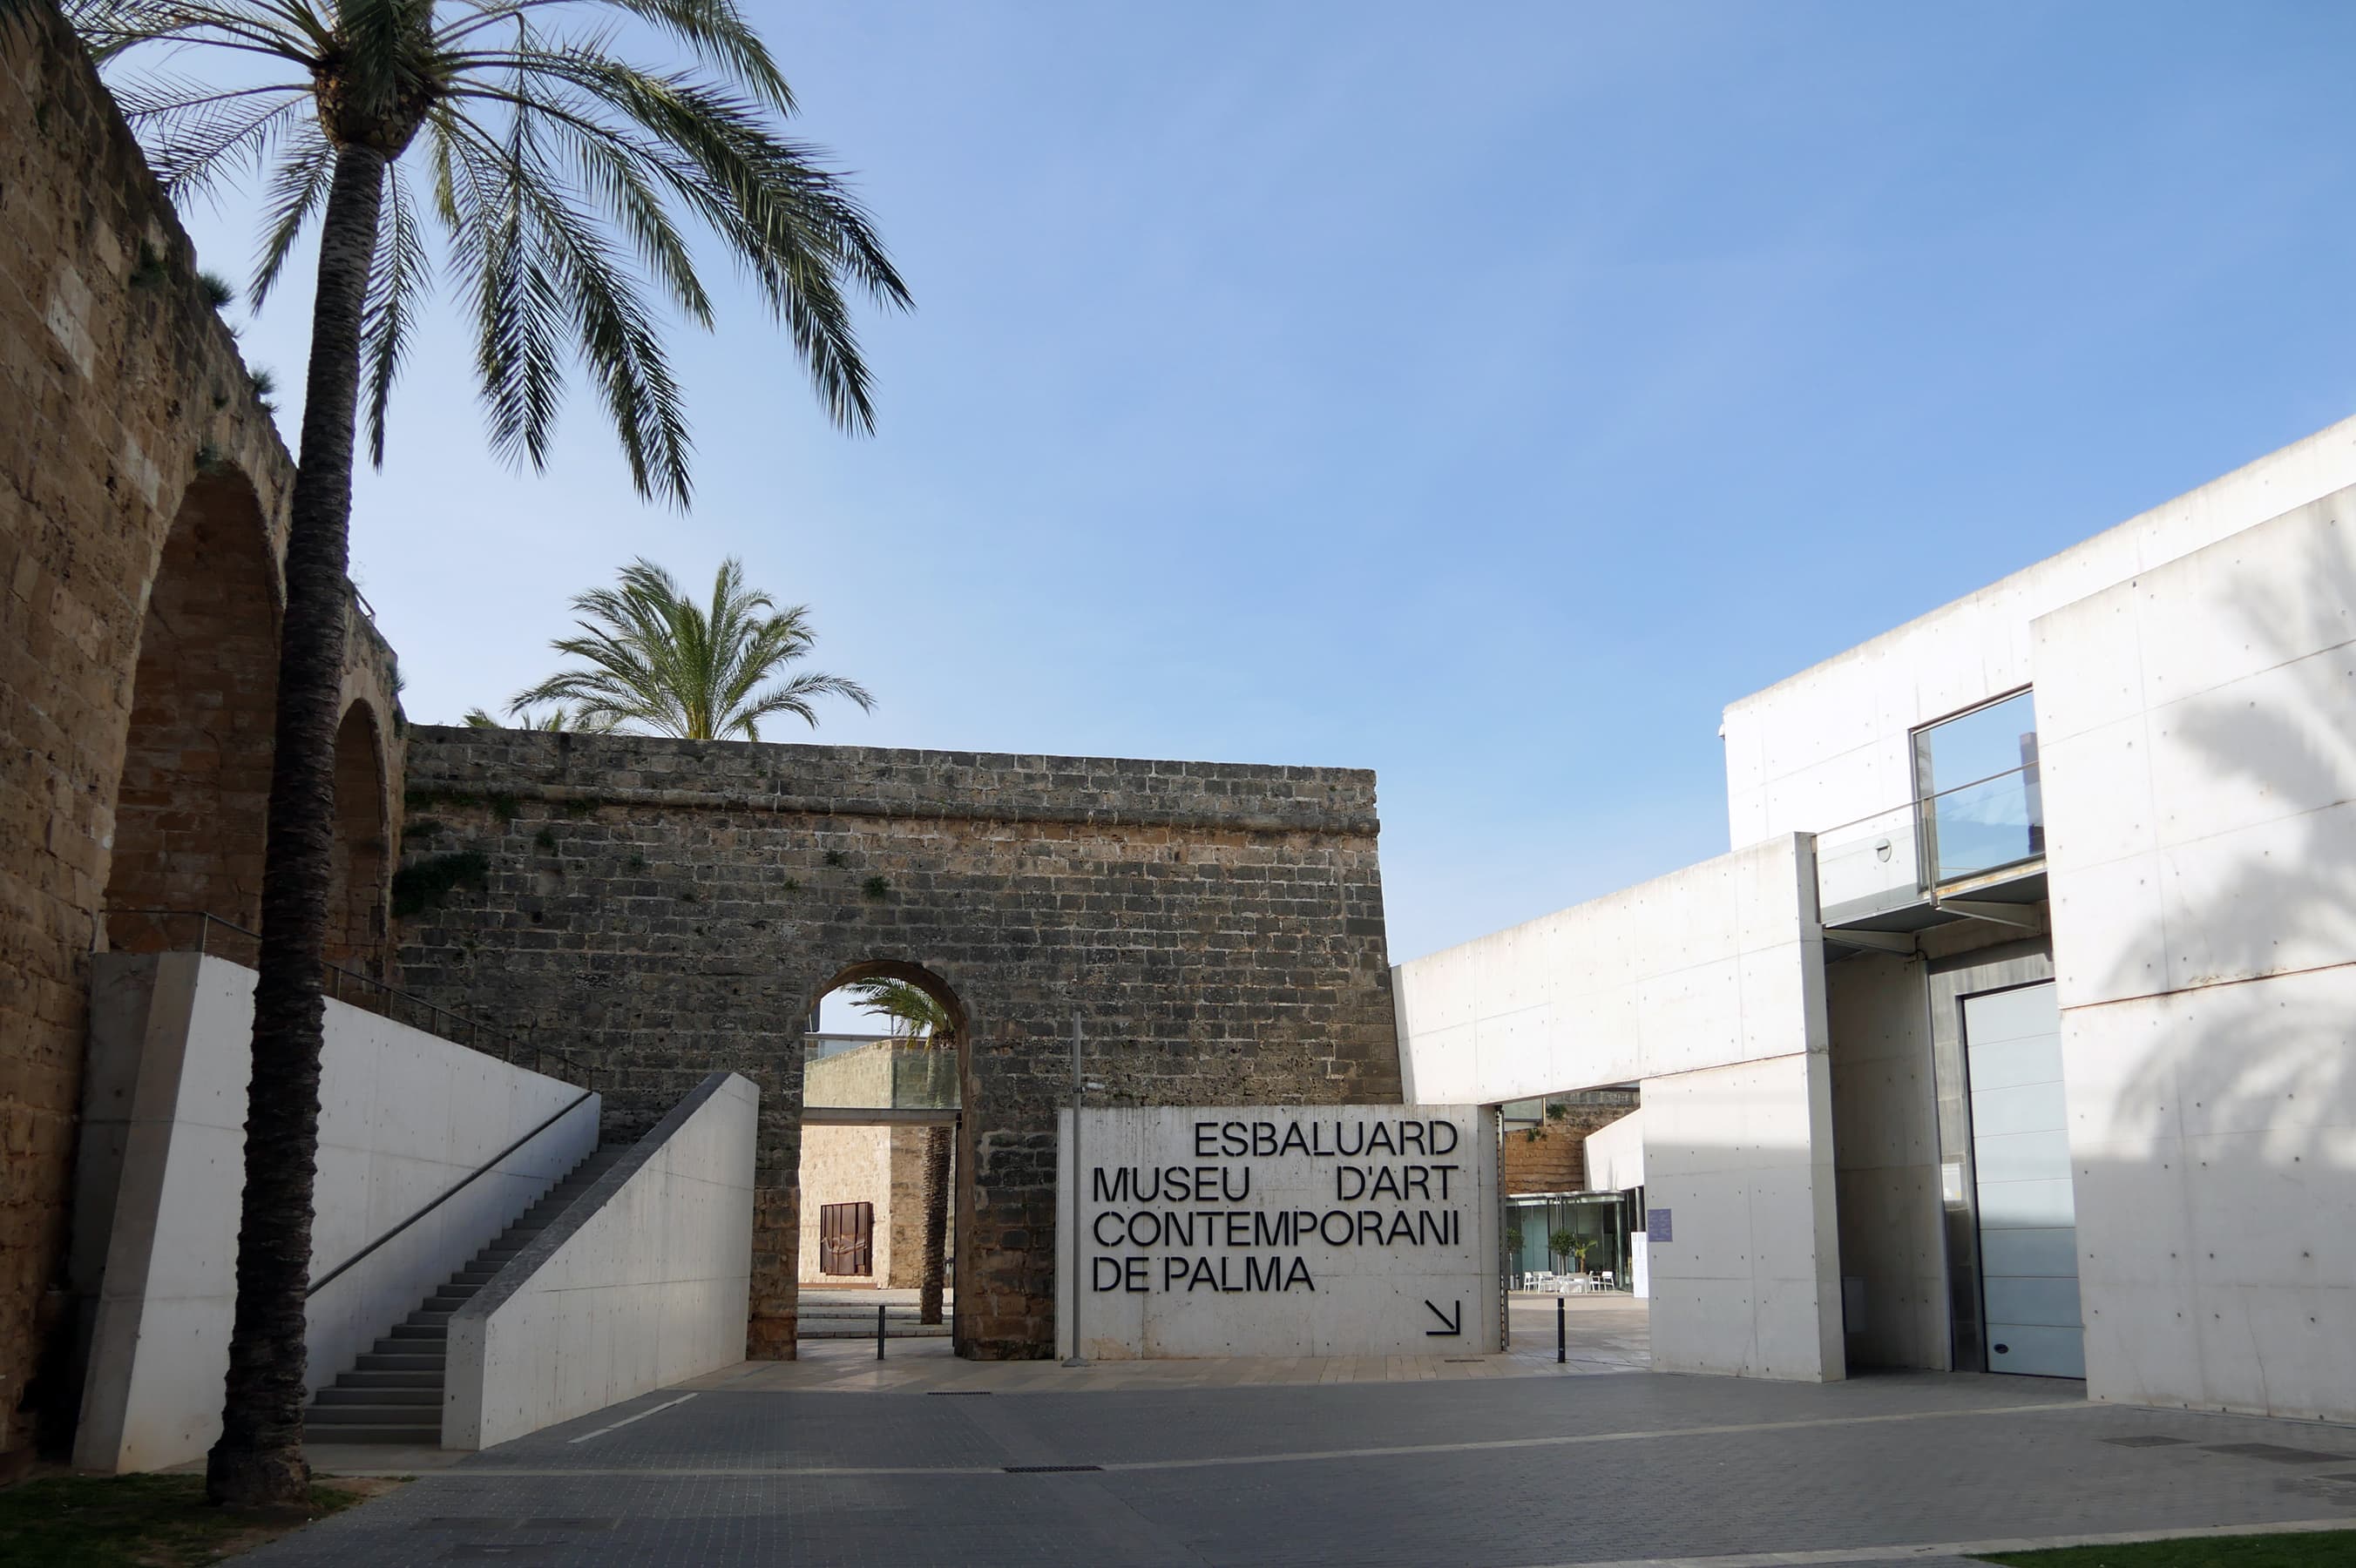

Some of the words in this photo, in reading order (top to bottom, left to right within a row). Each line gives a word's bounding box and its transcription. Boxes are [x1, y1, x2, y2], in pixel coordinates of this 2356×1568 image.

[1195, 1120, 1459, 1158] ESBALUARD
[1093, 1166, 1250, 1202] MUSEU
[1337, 1165, 1459, 1201] D'ART
[1093, 1209, 1459, 1247] CONTEMPORANI
[1093, 1256, 1150, 1292] DE
[1164, 1255, 1316, 1292] PALMA
